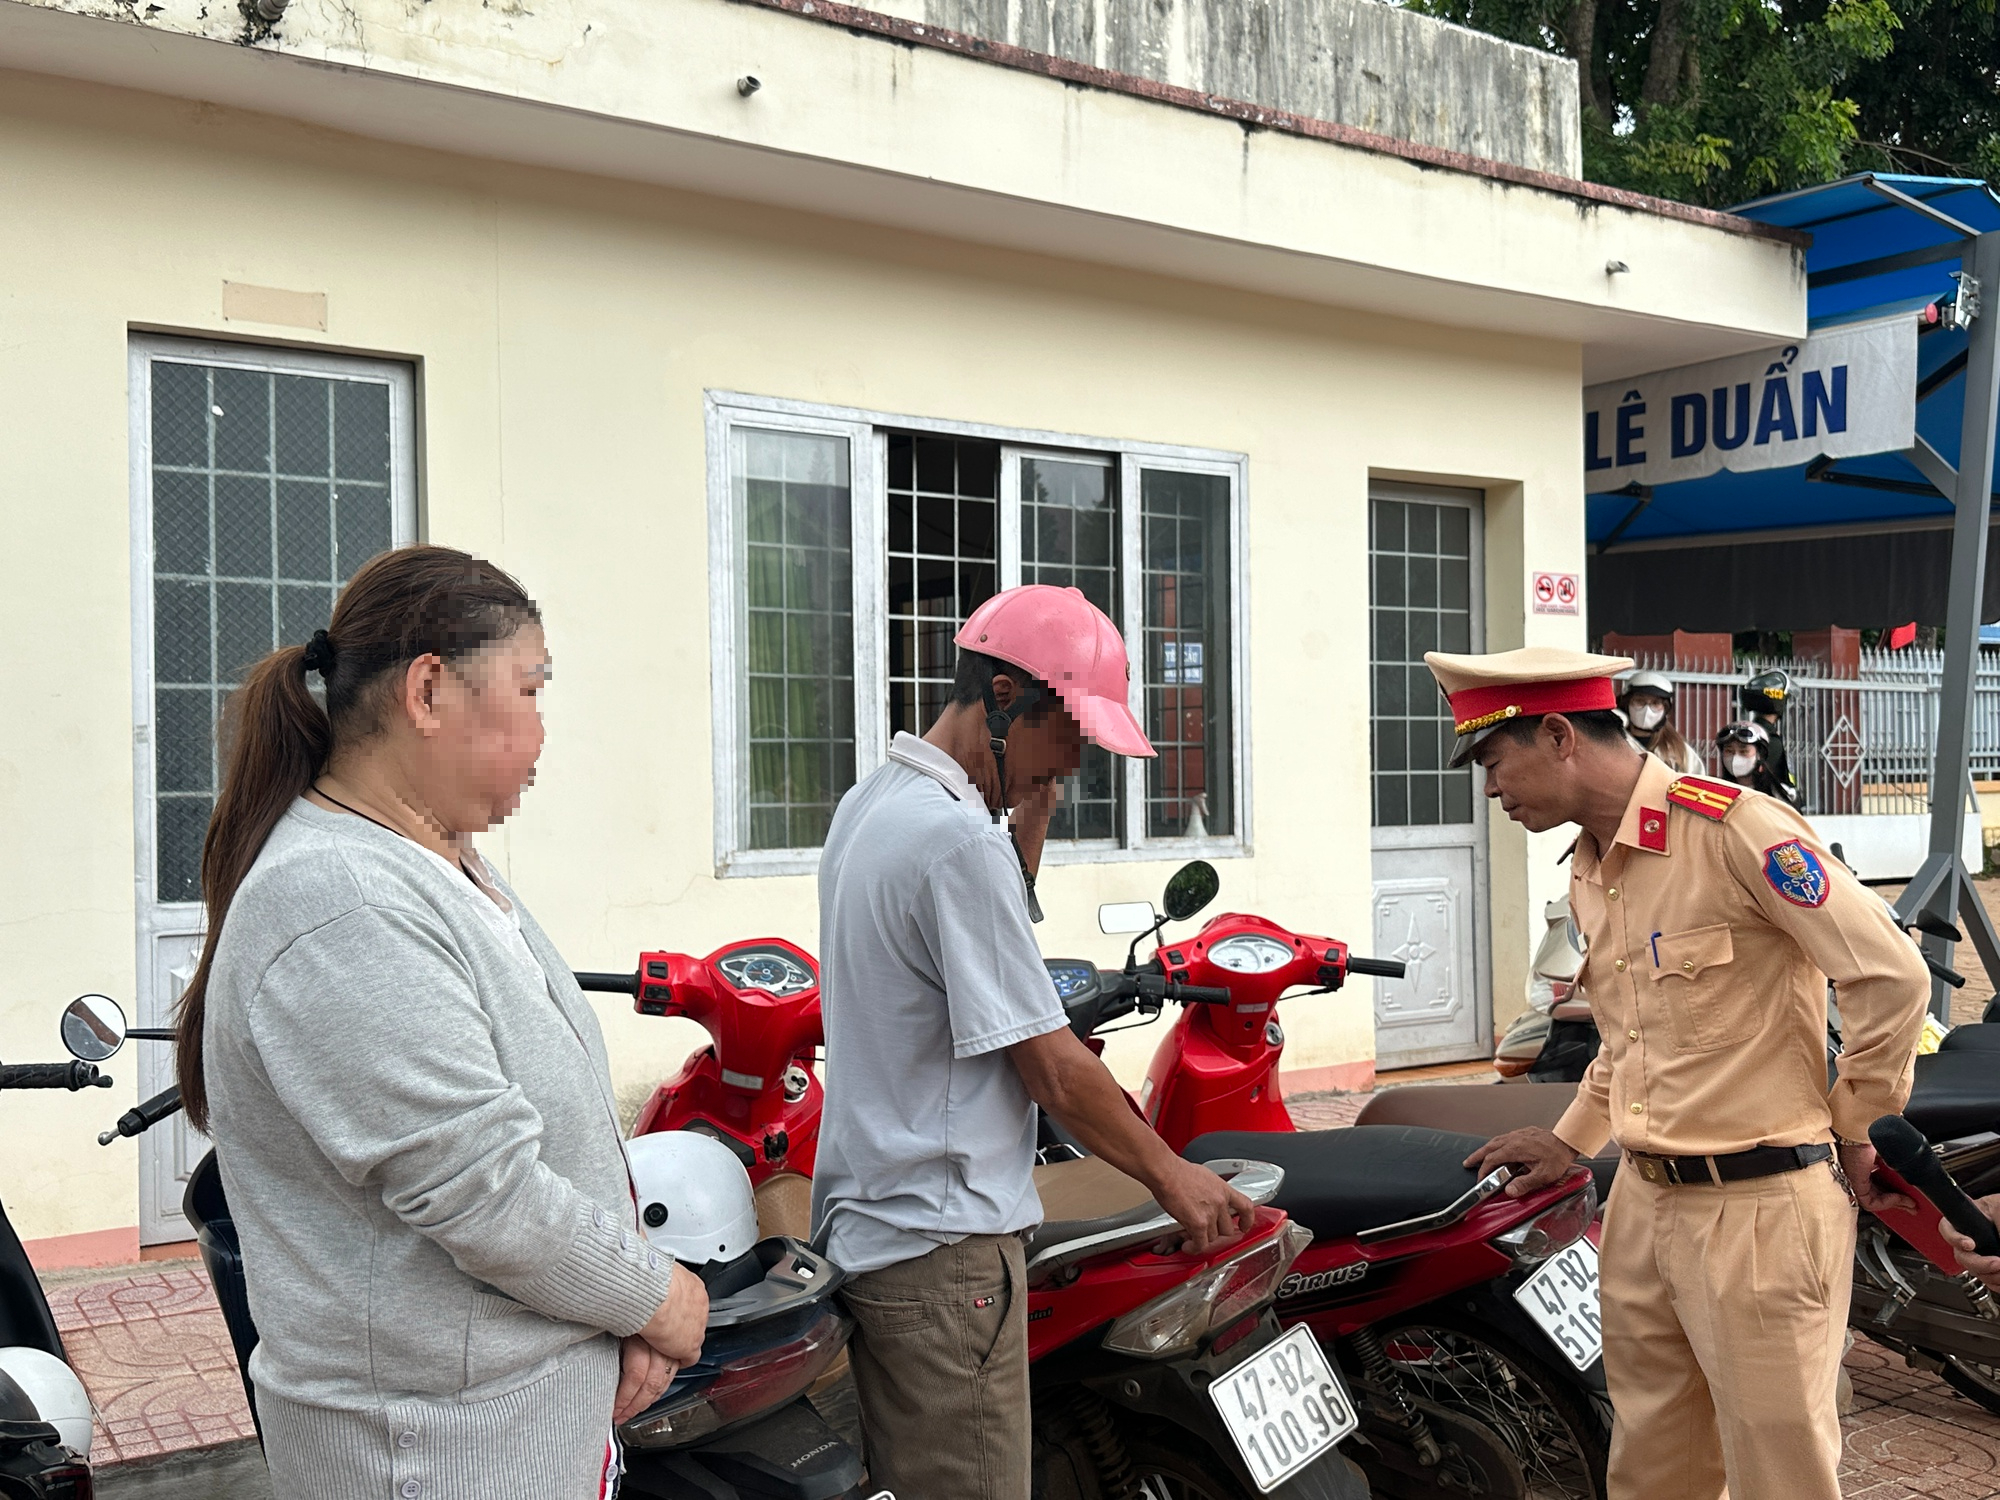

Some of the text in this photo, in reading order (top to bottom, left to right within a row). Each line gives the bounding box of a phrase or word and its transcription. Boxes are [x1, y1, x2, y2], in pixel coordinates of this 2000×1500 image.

[1586, 346, 1848, 472] LÊ DUẨN
[1782, 870, 1821, 891] CSGT
[1531, 1249, 1598, 1316] 47-B2
[1553, 1288, 1602, 1361] 516
[1232, 1343, 1316, 1422] 47-B2
[790, 1441, 839, 1468] HONDA
[1247, 1393, 1347, 1478] 100.96
